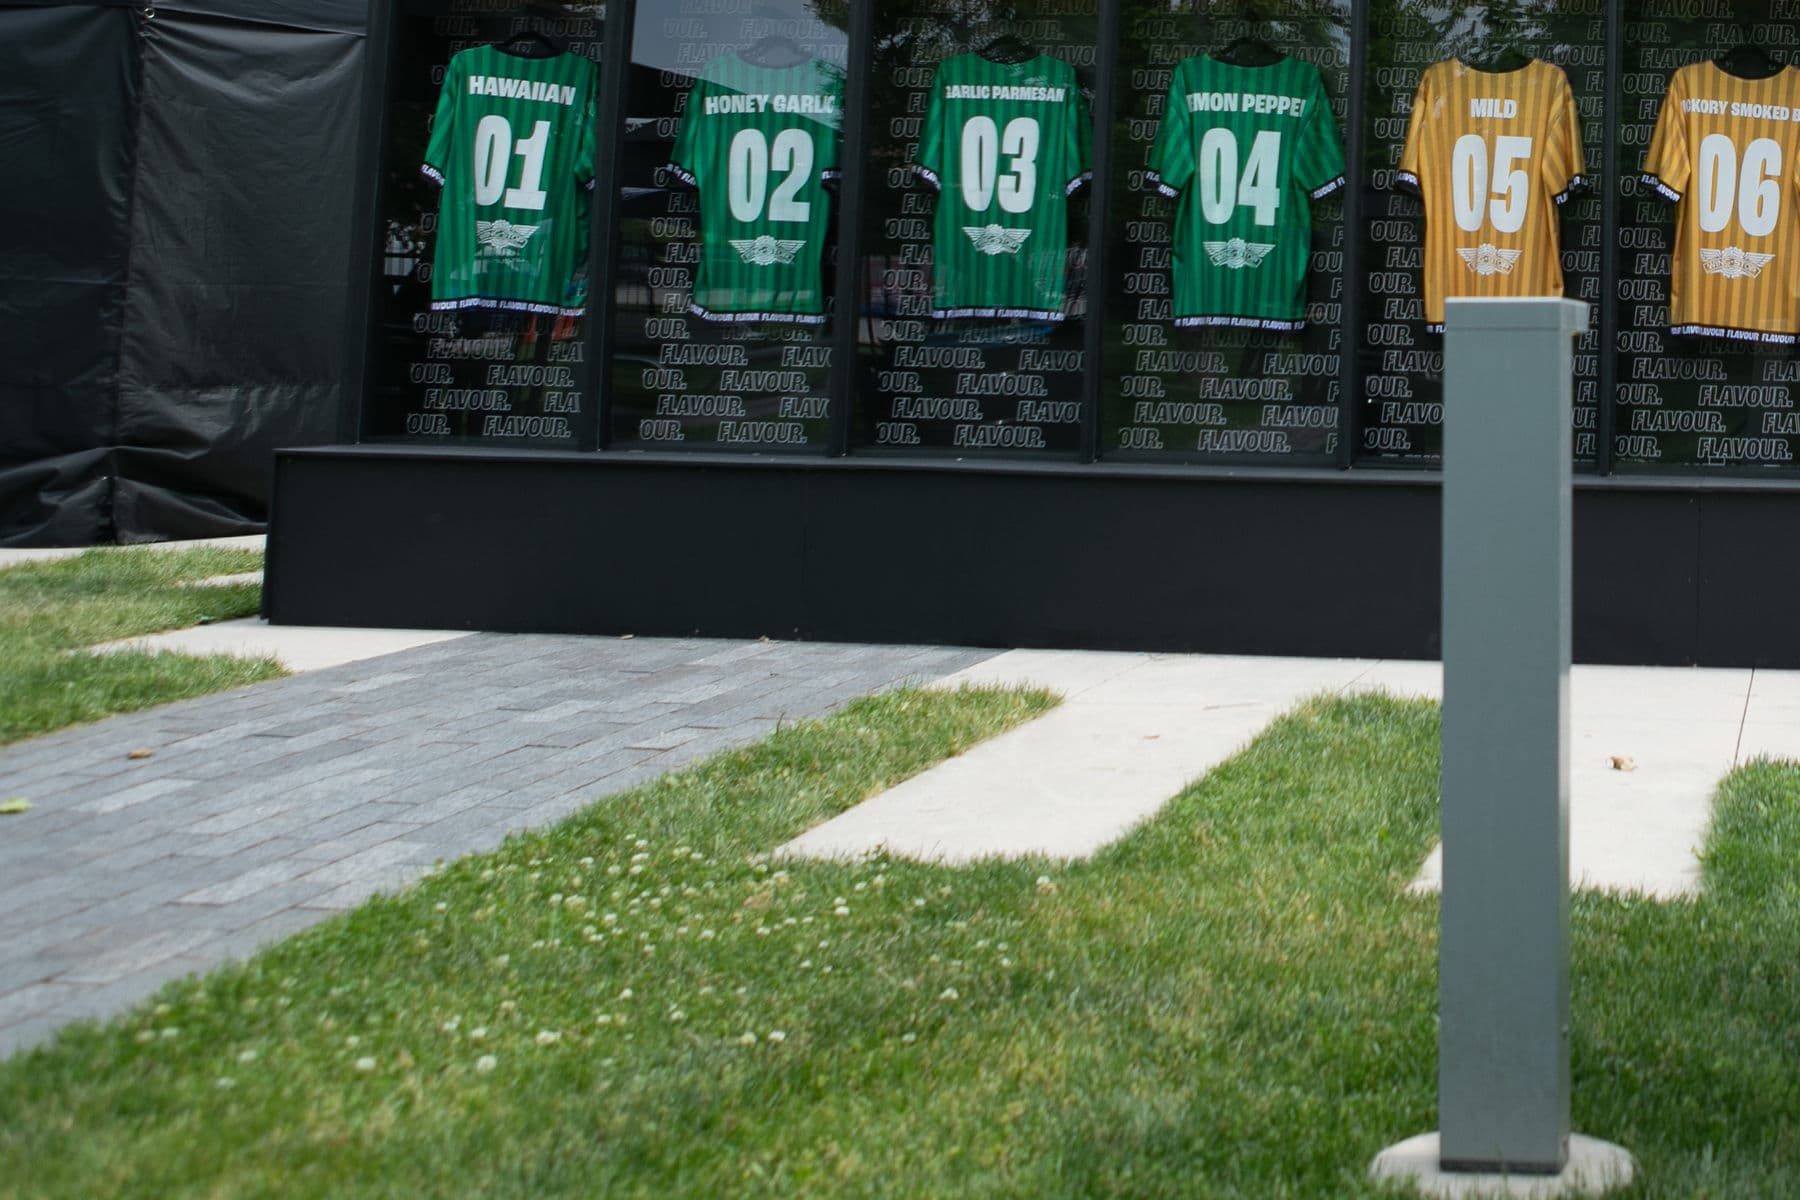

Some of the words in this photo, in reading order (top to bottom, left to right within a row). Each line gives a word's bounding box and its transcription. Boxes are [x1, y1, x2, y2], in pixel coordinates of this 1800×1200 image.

[469, 75, 576, 105] HAWAIIAN
[992, 85, 1065, 102] PARMESAN
[705, 94, 769, 115] HONEY
[1471, 99, 1517, 118] MILD
[1731, 102, 1790, 120] SMOKED
[474, 114, 551, 210] 01
[961, 115, 1039, 213] 03
[728, 128, 814, 222] 02
[1199, 128, 1281, 226] 04
[1452, 134, 1532, 233] 05
[1699, 134, 1782, 237] 06
[426, 338, 516, 361] FLAVOUR.
[659, 344, 749, 366] FLAVOUR.
[893, 345, 986, 369] FLAVOUR.
[1135, 350, 1229, 373] FLAVOUR.
[1632, 357, 1728, 380] FLAVOUR.
[486, 365, 575, 387] FLAVOUR.
[719, 370, 810, 393] FLAVOUR.
[955, 372, 1049, 397] FLAVOUR.
[423, 388, 512, 411] FLAVOUR.
[1199, 377, 1293, 401] FLAVOUR.
[1698, 385, 1794, 408] FLAVOUR.
[655, 394, 746, 417] FLAVOUR.
[890, 397, 984, 420] FLAVOUR.
[1133, 401, 1227, 425] FLAVOUR.
[482, 415, 572, 438] FLAVOUR.
[717, 421, 808, 443] FLAVOUR.
[1631, 410, 1727, 433] FLAVOUR.
[952, 424, 1046, 448] FLAVOUR.
[1197, 429, 1292, 453] FLAVOUR.
[1697, 437, 1793, 460] FLAVOUR.
